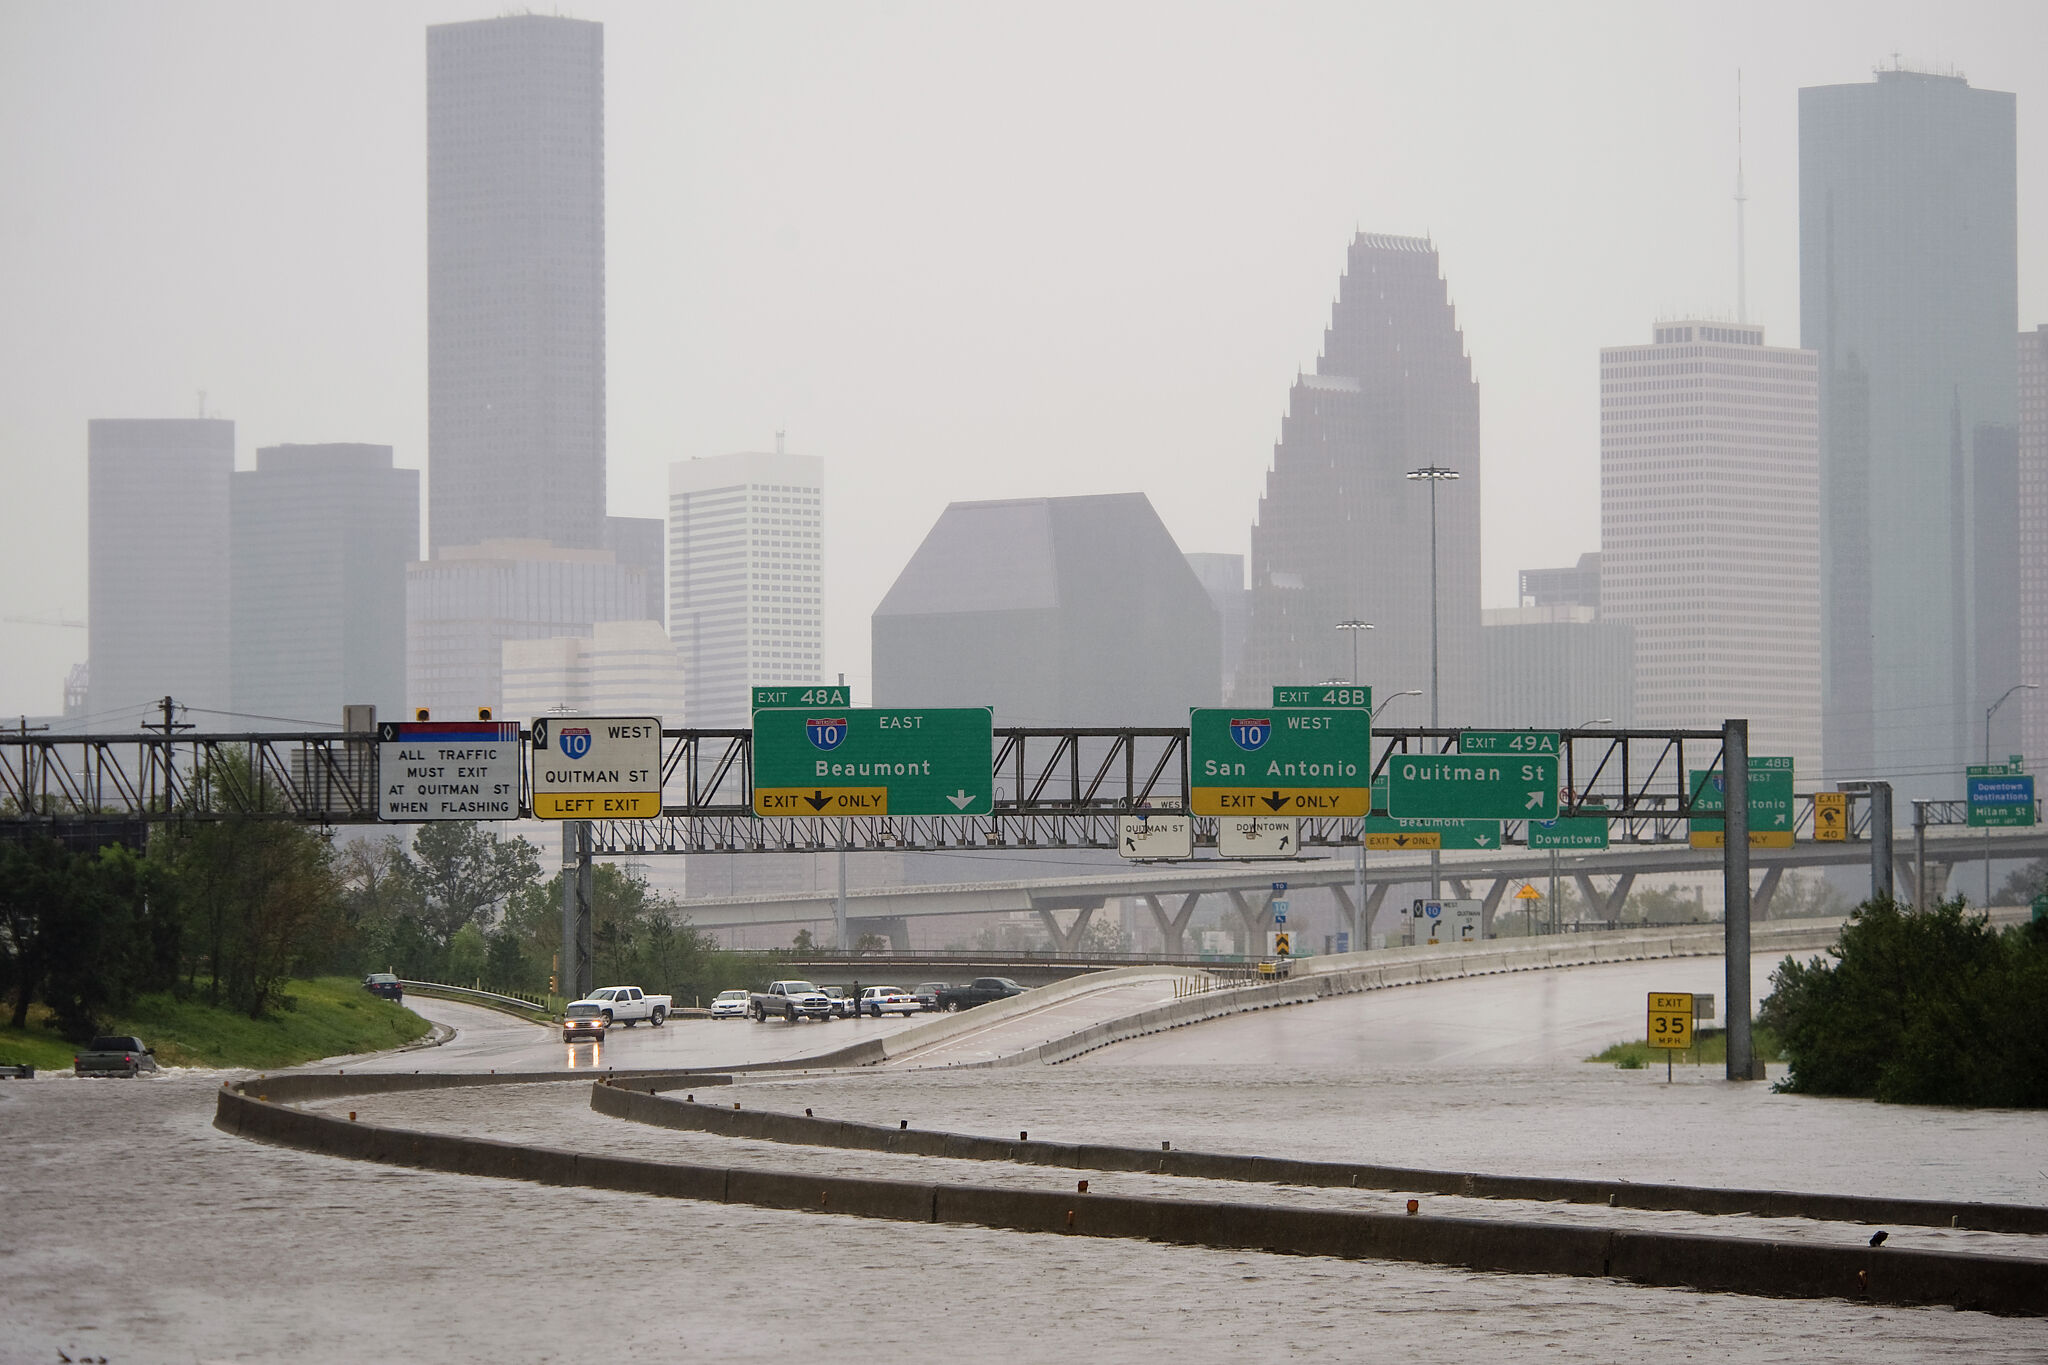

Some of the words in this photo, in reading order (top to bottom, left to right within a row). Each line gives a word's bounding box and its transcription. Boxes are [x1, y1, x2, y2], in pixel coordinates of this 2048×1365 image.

[758, 692, 787, 703] EXIT
[800, 690, 844, 704] 48A
[1280, 692, 1309, 702] EXIT
[1323, 690, 1364, 705] 48B
[880, 716, 923, 729] EAST
[1288, 717, 1332, 730] WEST
[608, 726, 652, 738] WEST
[816, 726, 838, 744] 10
[1240, 726, 1262, 744] 10
[566, 736, 586, 754] 10
[1466, 737, 1497, 748] EXIT
[1509, 736, 1554, 751] 49A
[398, 750, 425, 760] ALL
[438, 750, 497, 760] TRAFFIC
[816, 760, 930, 776] Beaumont
[1205, 760, 1246, 776] San
[1266, 760, 1357, 776] Antonio
[1765, 758, 1790, 768] 48B
[407, 768, 444, 778] MUST
[458, 768, 488, 778] EXIT
[546, 770, 620, 783] QUITMAN
[628, 770, 649, 782] ST
[1402, 764, 1500, 780] Quitman
[1521, 765, 1544, 780] St
[389, 785, 404, 795] AT
[418, 785, 480, 796] QUITMAN
[493, 784, 510, 794] ST
[763, 796, 798, 808] EXIT
[838, 795, 882, 808] ONLY
[1221, 796, 1256, 808] EXIT
[1296, 796, 1340, 808] ONLY
[1698, 800, 1722, 808] San
[1818, 794, 1841, 803] EXIT
[390, 802, 428, 813] WHEN
[441, 802, 510, 813] FLASHING
[554, 800, 594, 812] LEFT
[604, 800, 640, 812] EXIT
[1976, 808, 2008, 816] Milam
[2016, 808, 2026, 816] St
[1172, 824, 1184, 832] ST
[1823, 830, 1838, 838] 40
[1370, 837, 1390, 845] EXIT
[1412, 837, 1437, 845] ONLY
[1536, 834, 1601, 844] Downtown
[1749, 836, 1768, 844] NLY
[1274, 902, 1287, 911] 10
[1657, 998, 1684, 1008] EXIT
[1655, 1017, 1684, 1034] 35
